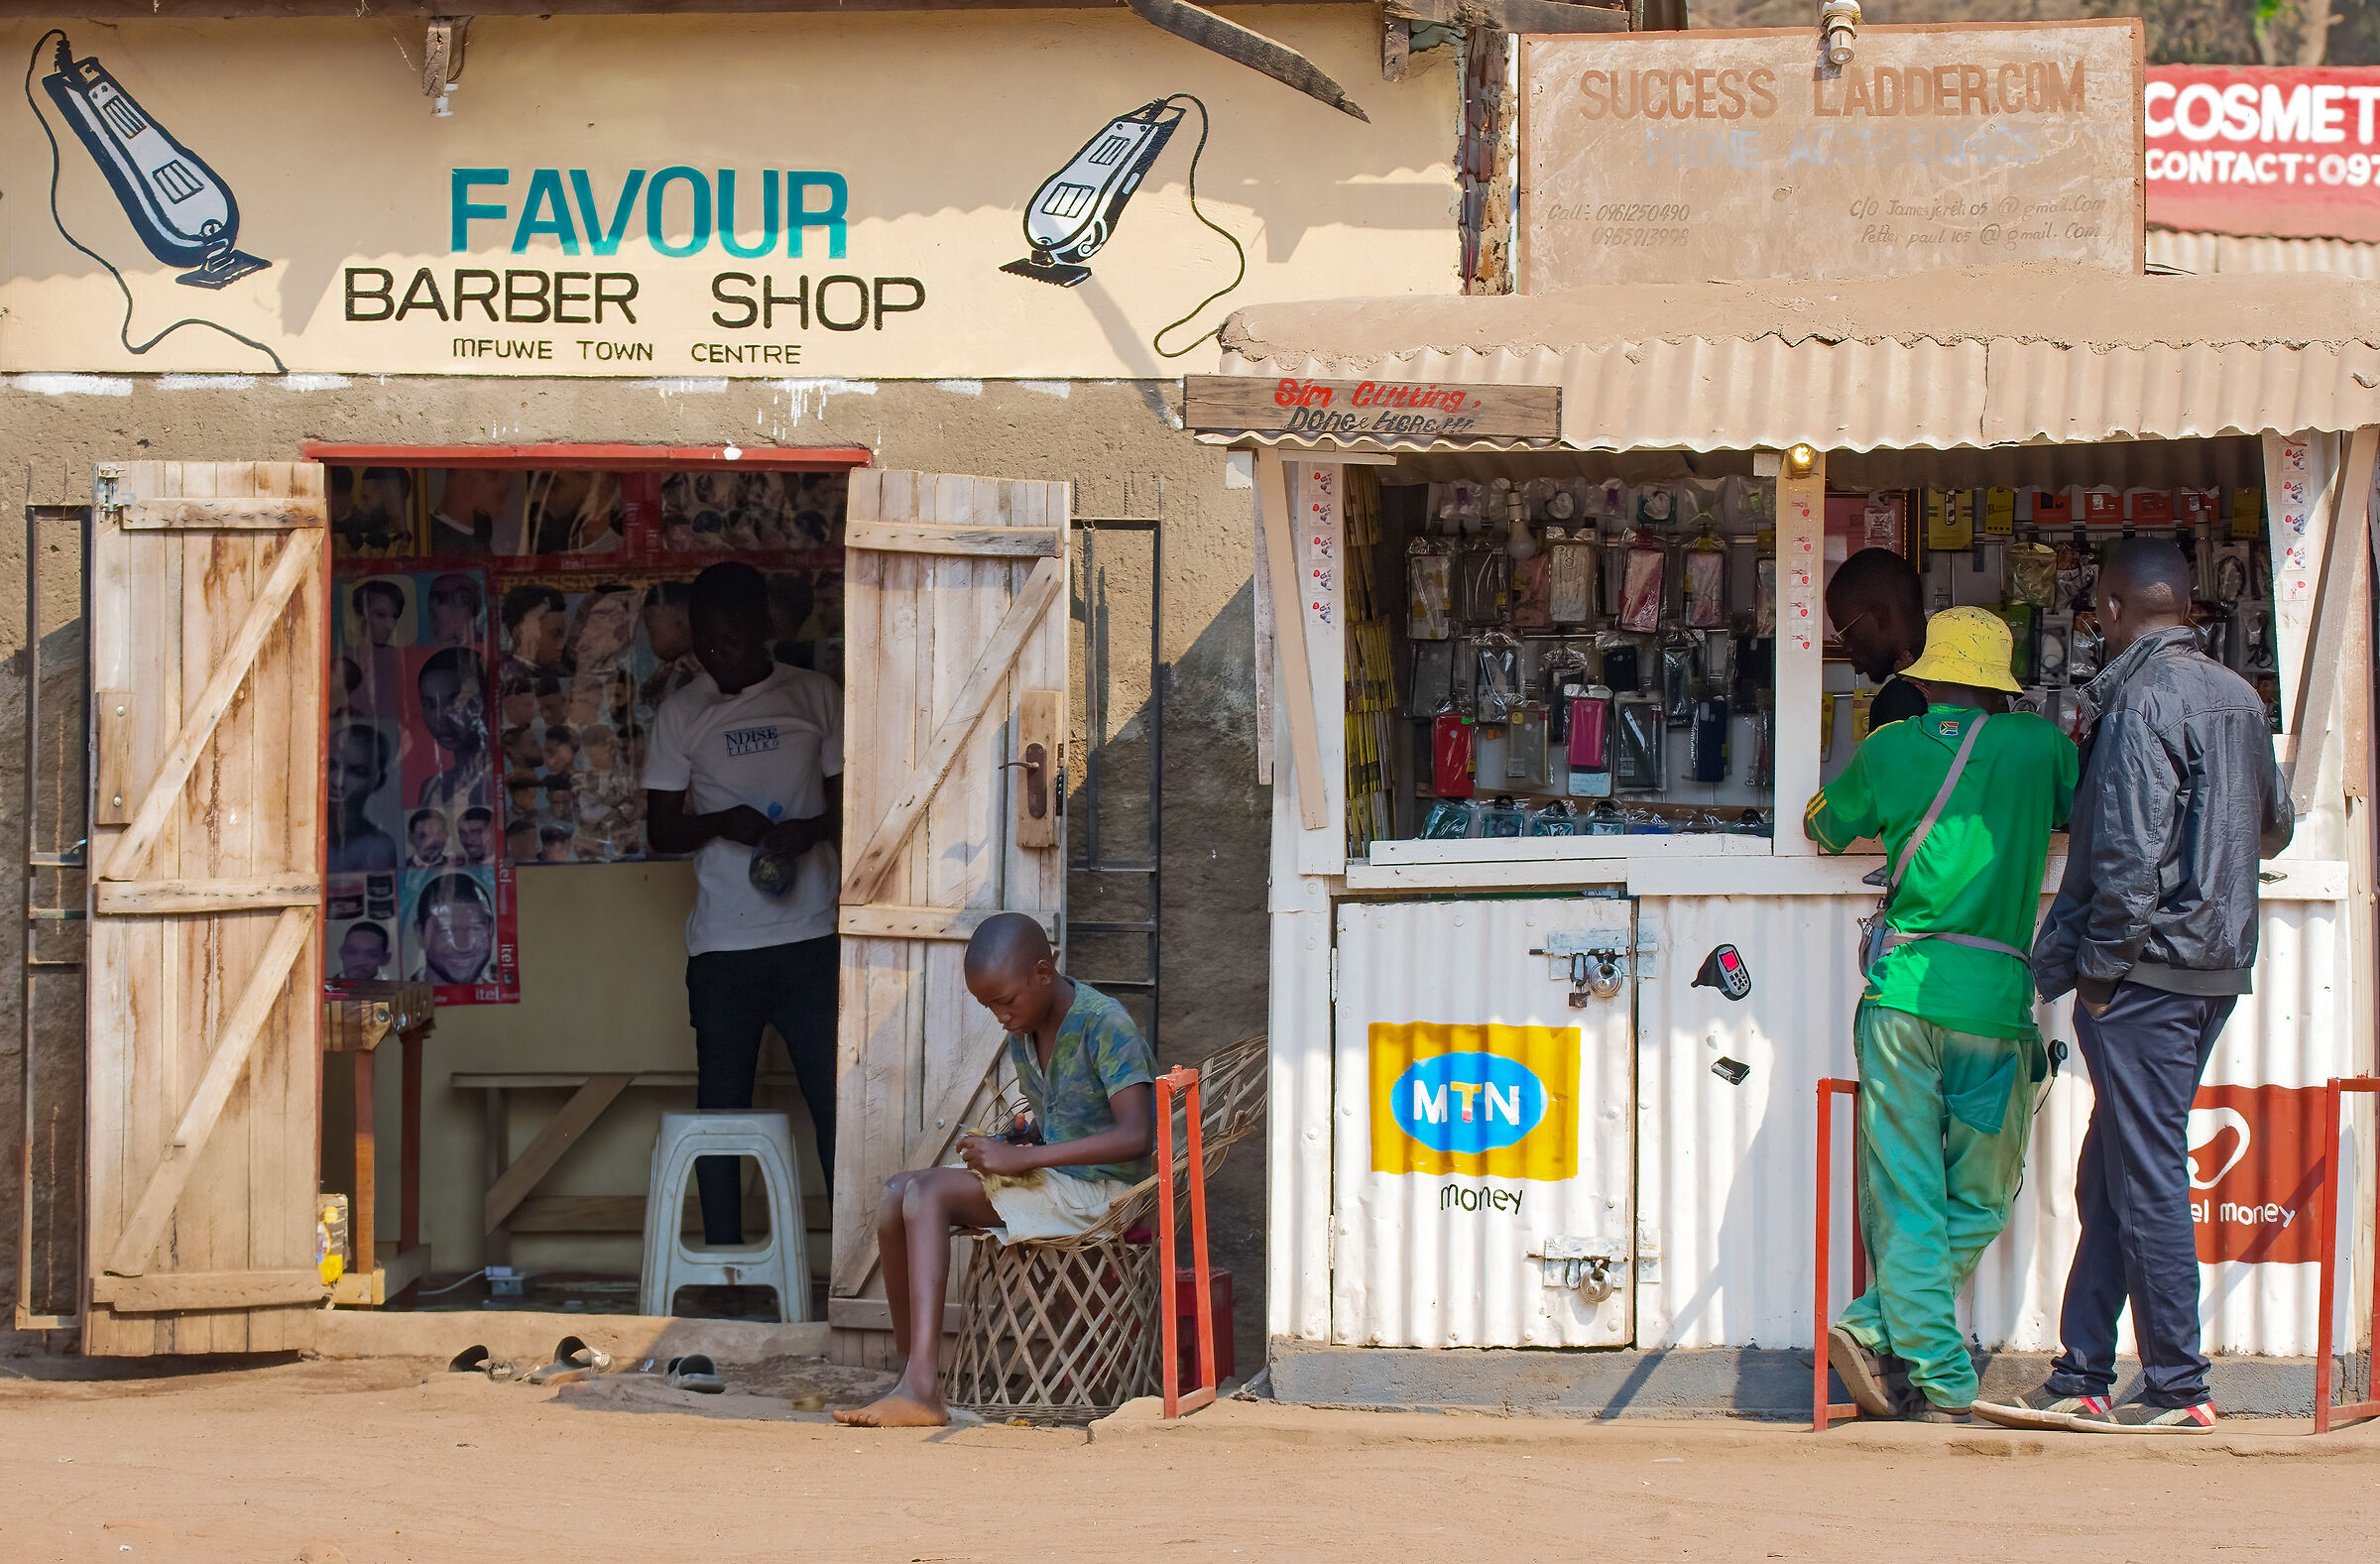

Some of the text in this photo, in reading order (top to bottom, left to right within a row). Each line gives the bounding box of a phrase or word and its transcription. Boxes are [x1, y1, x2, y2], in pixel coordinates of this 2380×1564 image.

[1579, 60, 2086, 120] SUCCESS LADDER.COM
[2144, 81, 2380, 145] COSMET
[1646, 130, 1760, 170] PHONE
[450, 165, 849, 259] FAVOUR
[1596, 203, 1691, 222] 0961250490
[344, 267, 926, 331] BARBER SHOP
[452, 337, 802, 365] MFUWE TOWN CENTRE
[1274, 378, 1333, 409] Sim
[475, 985, 500, 1001] itel
[1413, 1080, 1520, 1126] MTN
[1440, 1183, 1523, 1215] money
[2219, 1201, 2296, 1228] money
